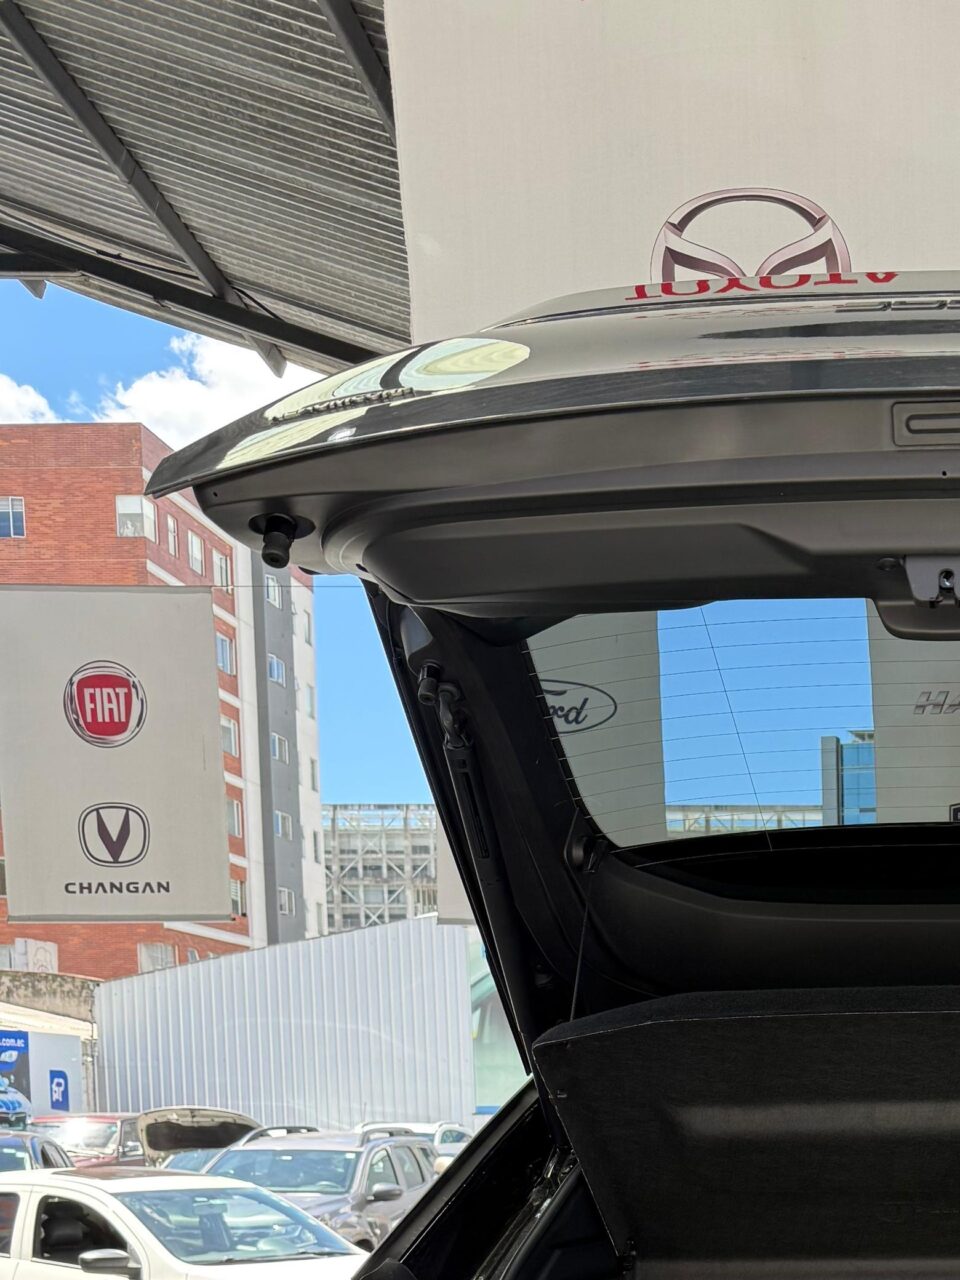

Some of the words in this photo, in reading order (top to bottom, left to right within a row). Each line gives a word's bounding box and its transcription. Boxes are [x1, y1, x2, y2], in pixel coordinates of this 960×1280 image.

[83, 687, 128, 723] FIAT
[543, 689, 588, 725] ord
[64, 881, 170, 894] CHANGAN
